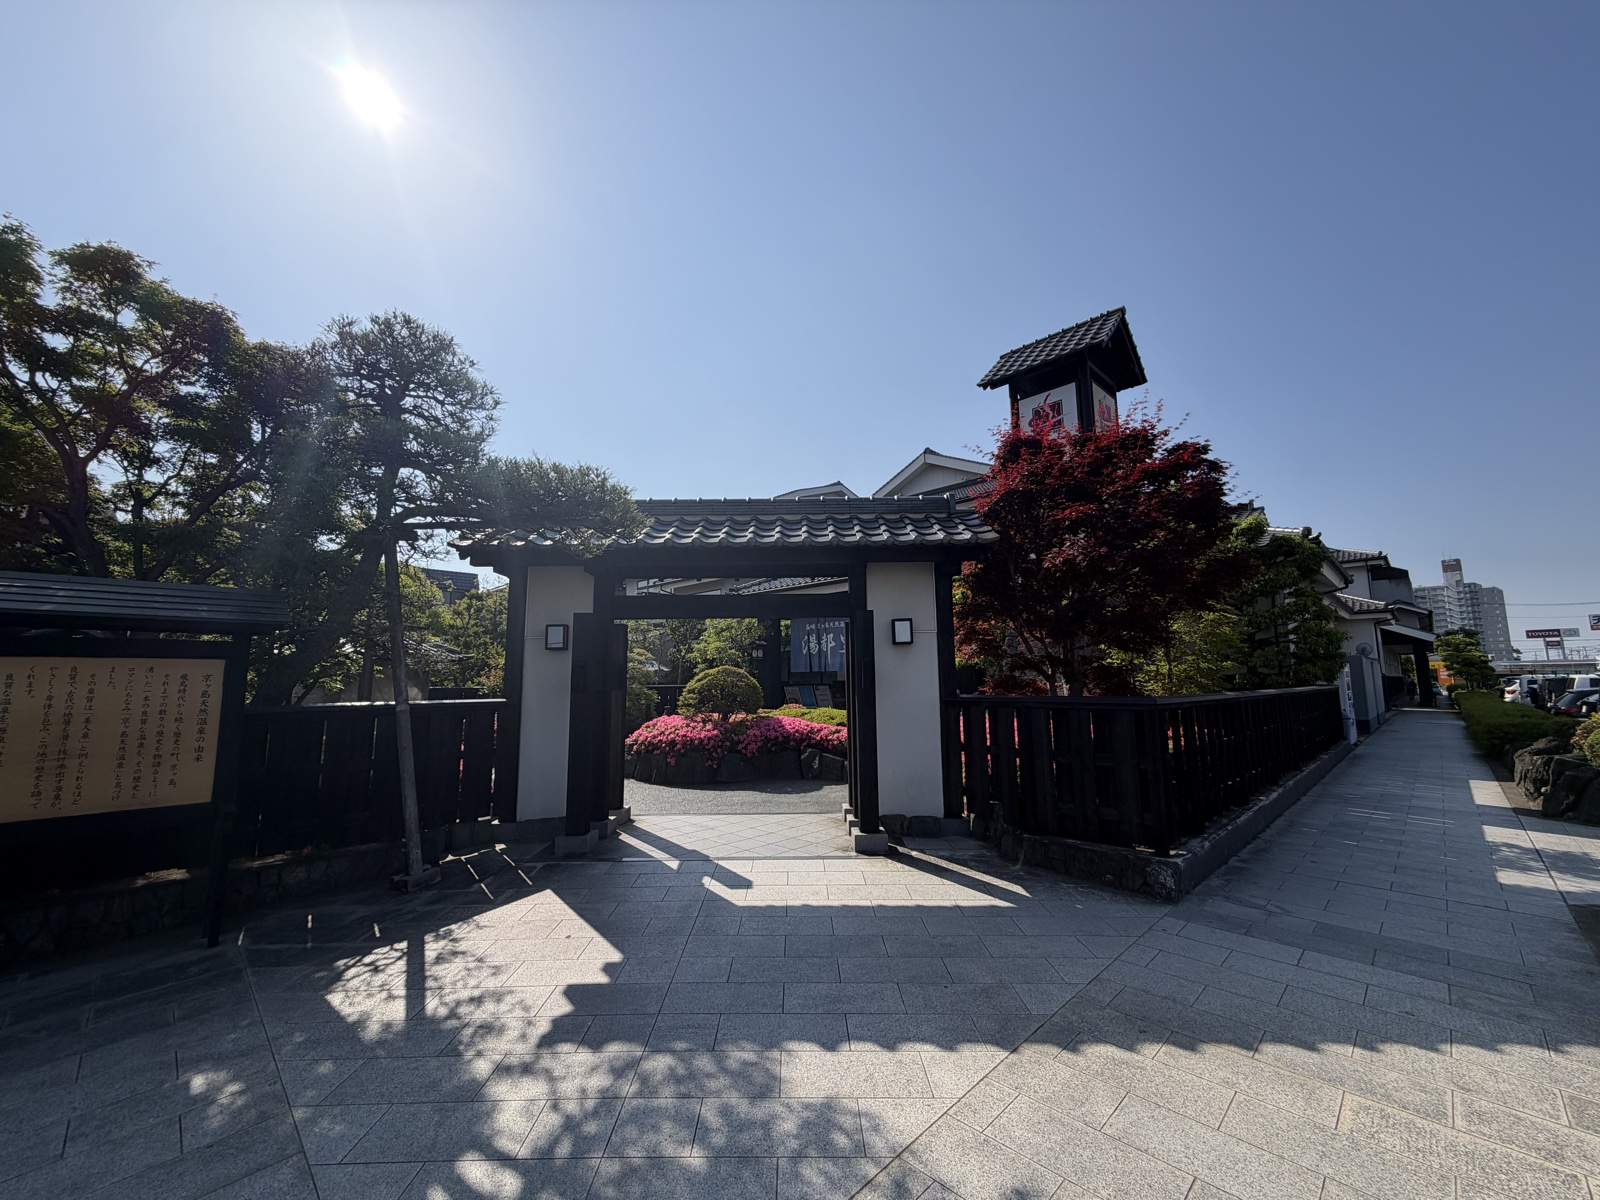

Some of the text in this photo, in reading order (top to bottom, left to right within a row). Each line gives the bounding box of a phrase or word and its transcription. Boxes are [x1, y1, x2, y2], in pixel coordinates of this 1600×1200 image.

[24, 665, 36, 699] くれます。
[107, 666, 117, 689] ました。
[193, 673, 213, 763] 京ヶ島天然温泉の由来
